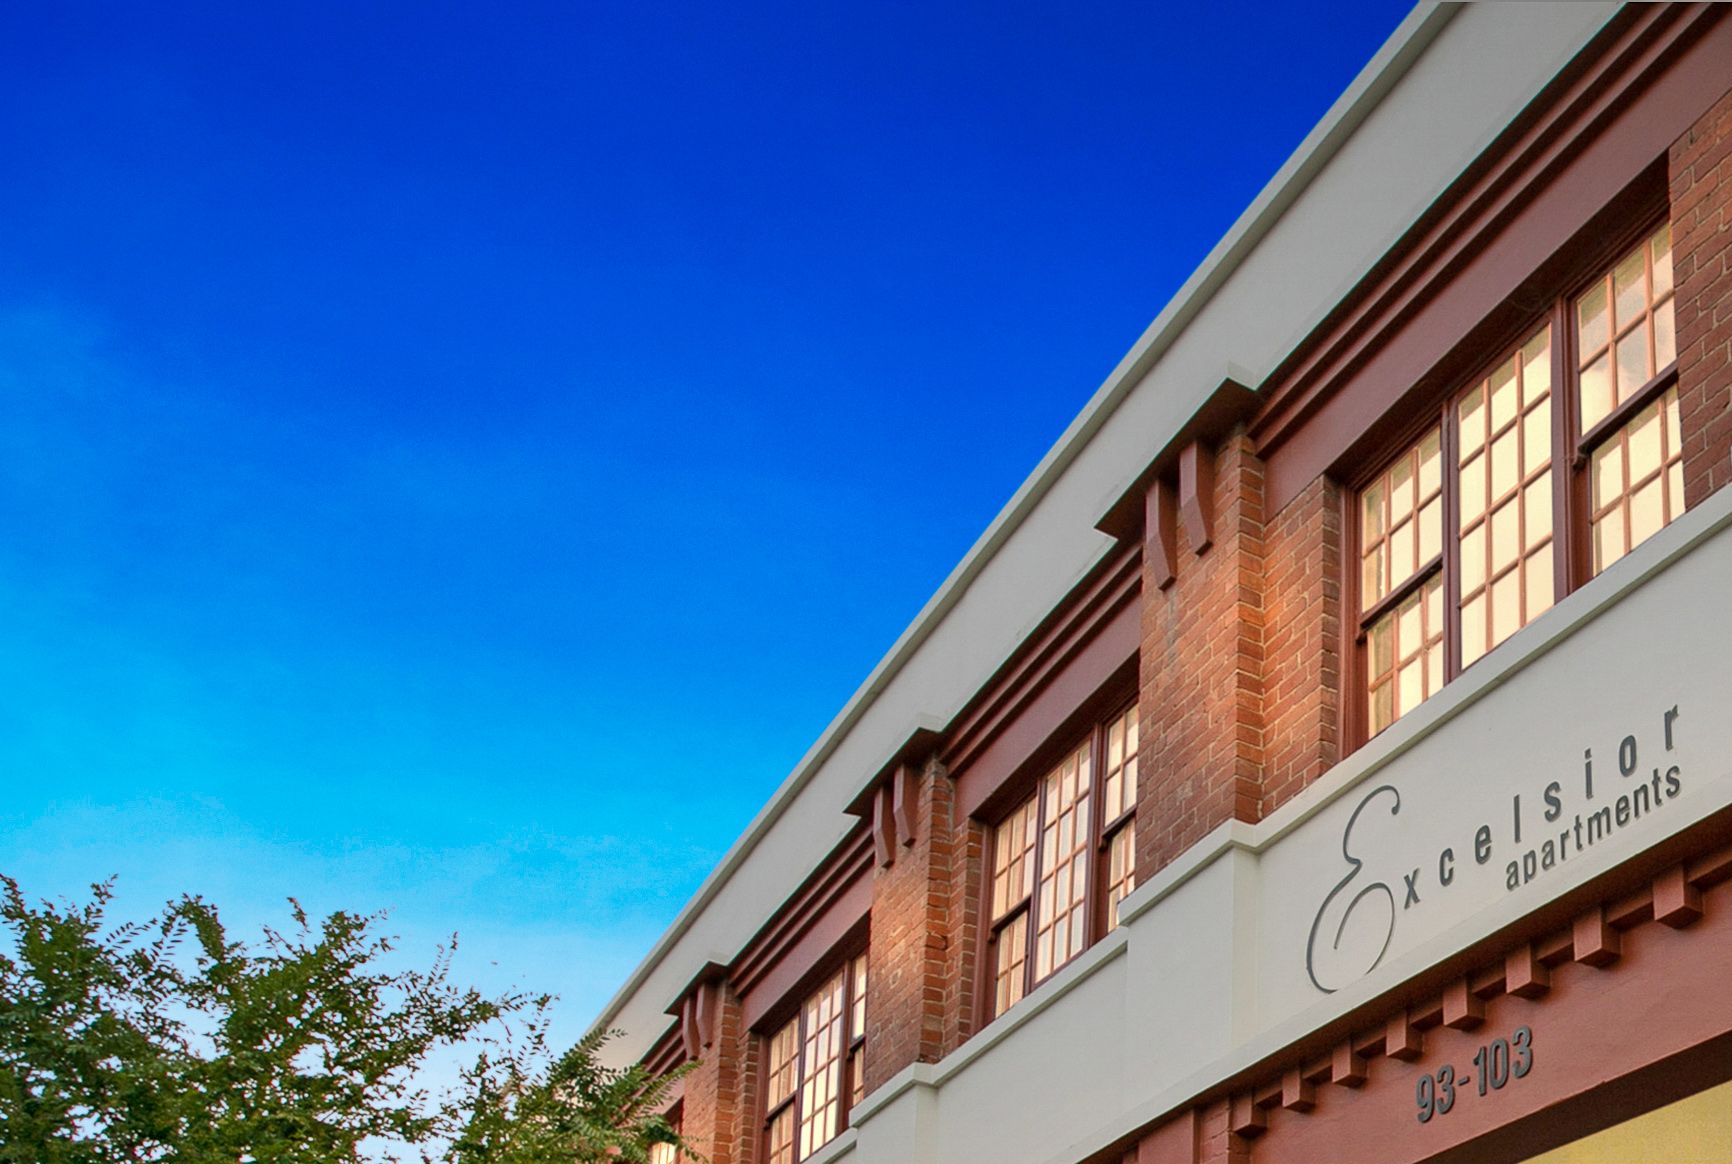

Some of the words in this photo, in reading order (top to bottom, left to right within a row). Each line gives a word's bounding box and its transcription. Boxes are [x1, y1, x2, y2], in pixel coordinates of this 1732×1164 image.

[1306, 703, 1680, 994] Excelsior
[1505, 764, 1681, 892] apartments
[1415, 1024, 1534, 1124] 93-103
